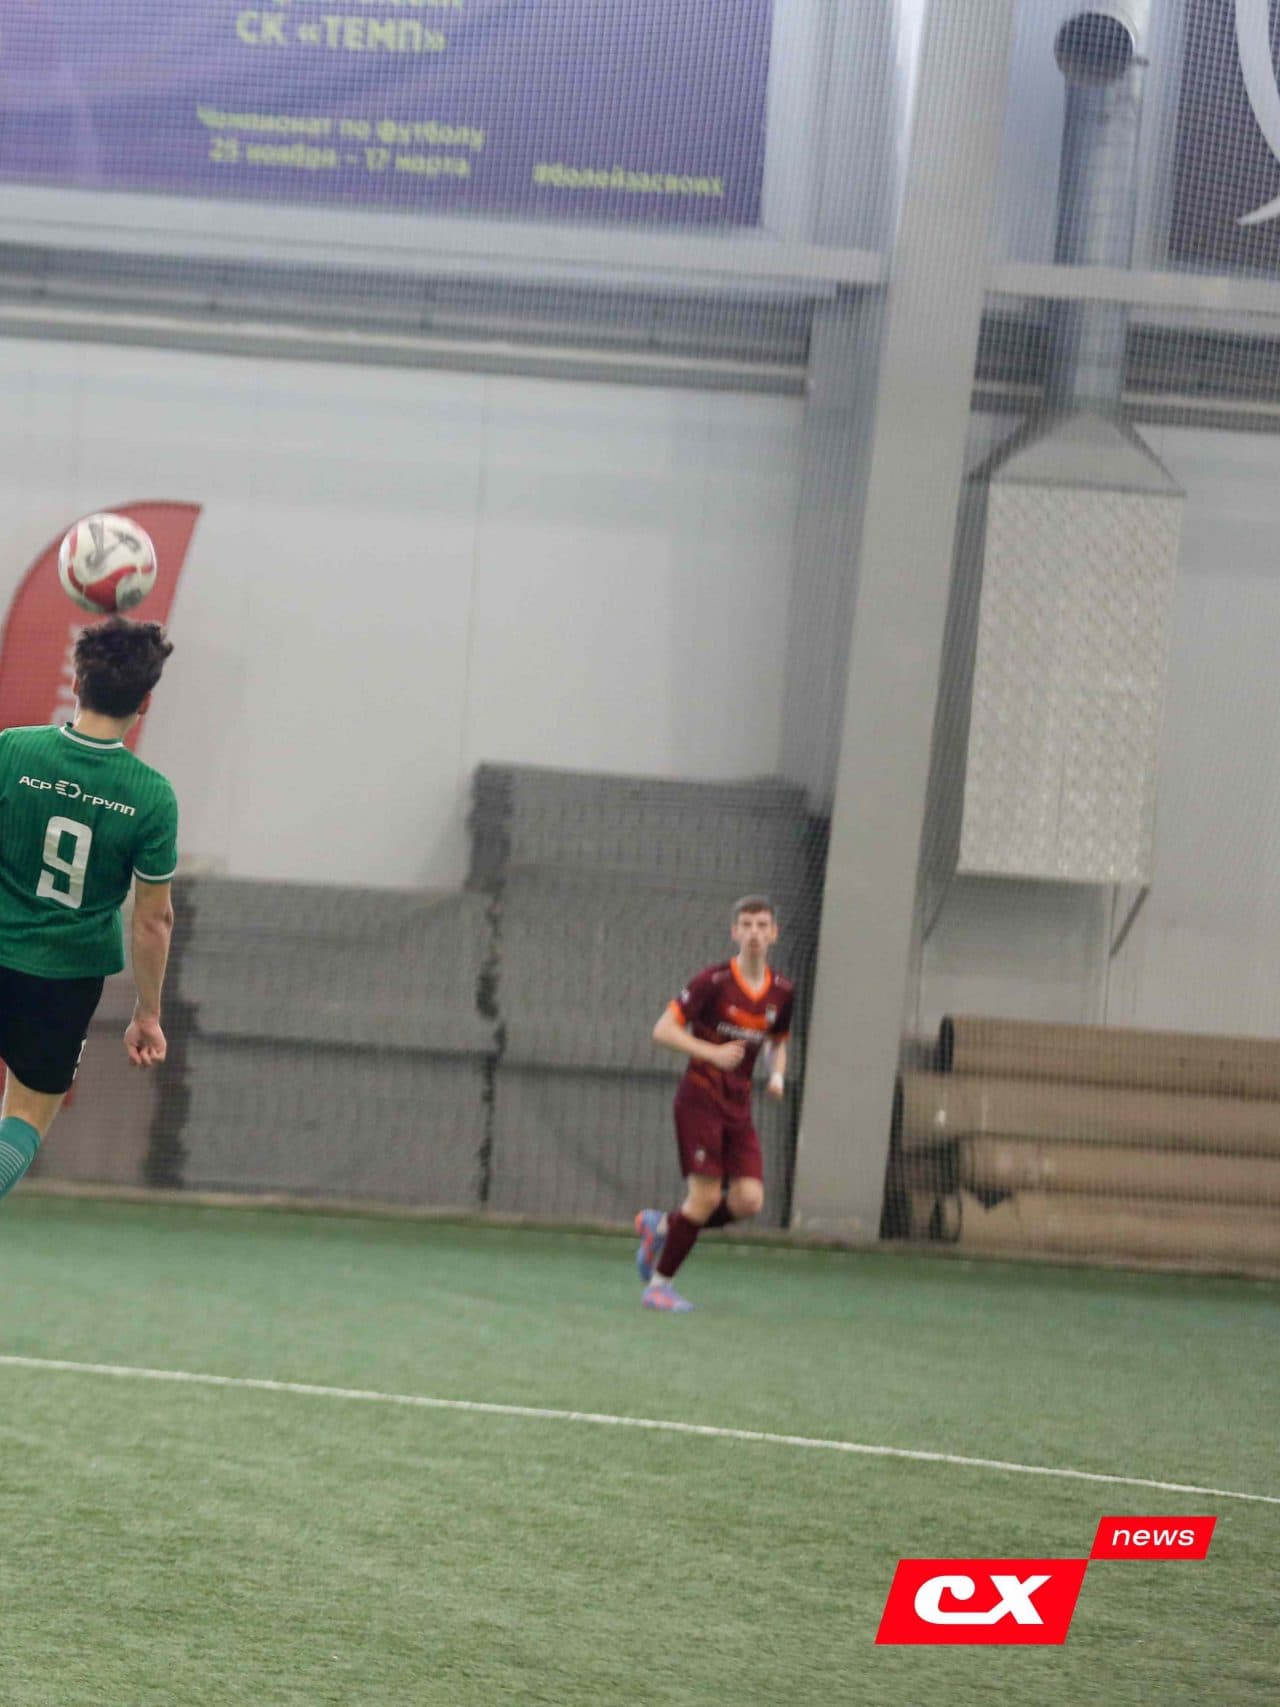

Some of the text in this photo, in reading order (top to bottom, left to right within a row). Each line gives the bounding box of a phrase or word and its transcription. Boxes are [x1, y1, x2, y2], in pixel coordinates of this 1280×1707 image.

[236, 10, 449, 53] СК «ТЕМП»
[339, 117, 370, 140] по
[395, 154, 472, 180] марта
[18, 775, 52, 791] АСР
[35, 815, 93, 910] 9
